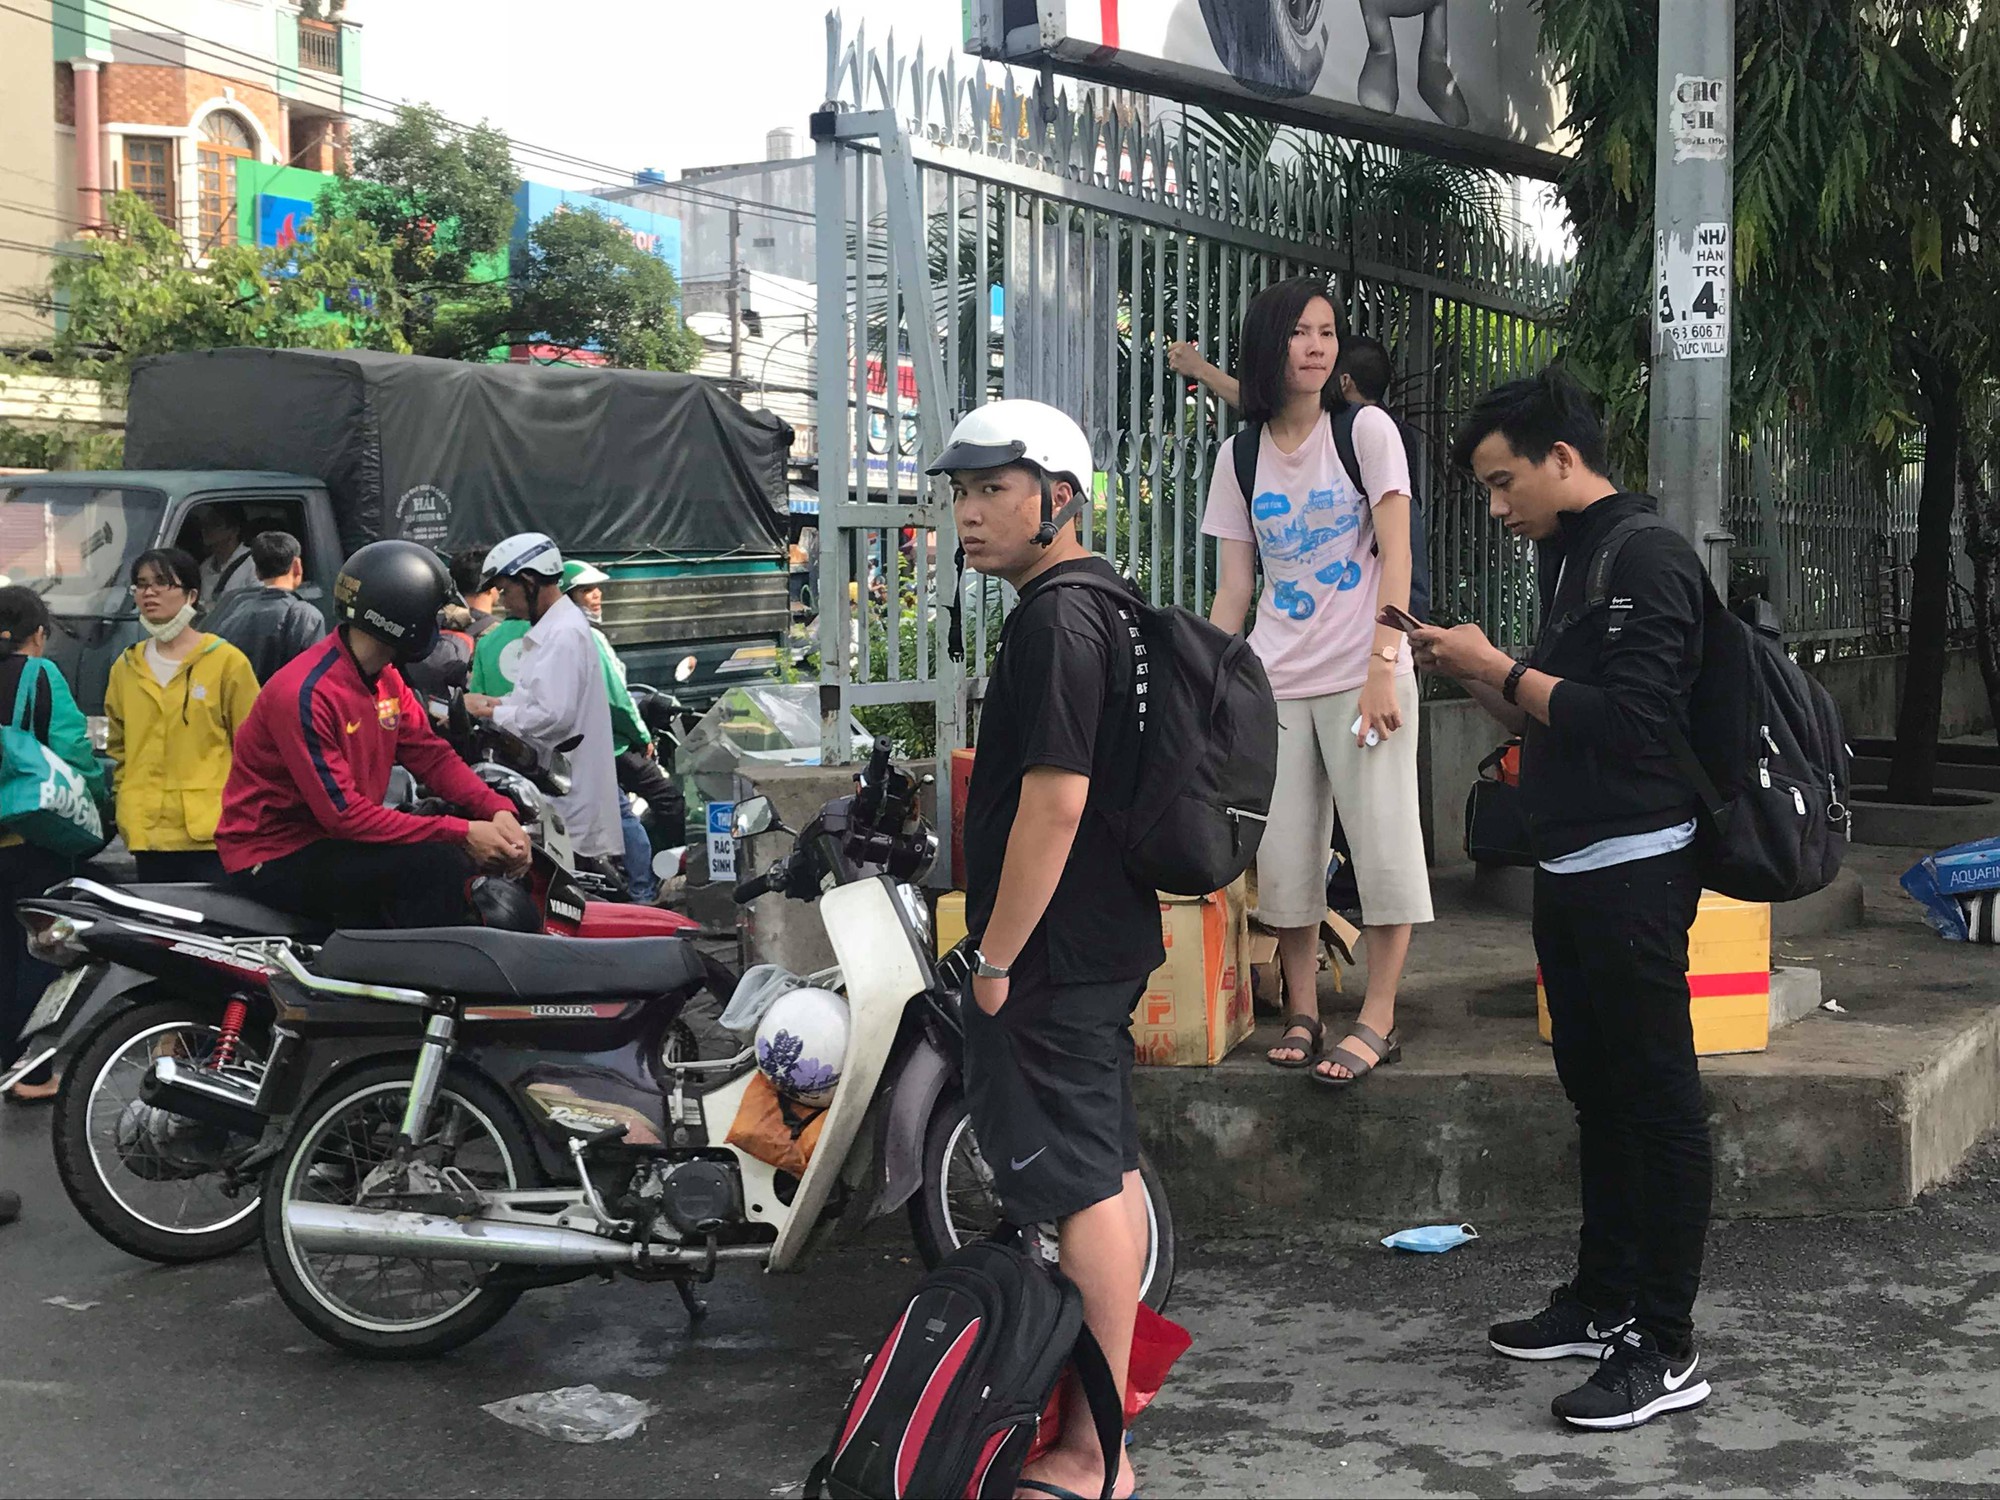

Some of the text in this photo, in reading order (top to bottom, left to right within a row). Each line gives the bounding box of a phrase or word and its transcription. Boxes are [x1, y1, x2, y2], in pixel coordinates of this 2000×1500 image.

[1697, 248, 1726, 262] HÀN
[1691, 325, 1713, 338] 606
[711, 859, 732, 873] SINH
[550, 898, 582, 922] YAMAHA
[532, 1004, 597, 1016] HONDA
